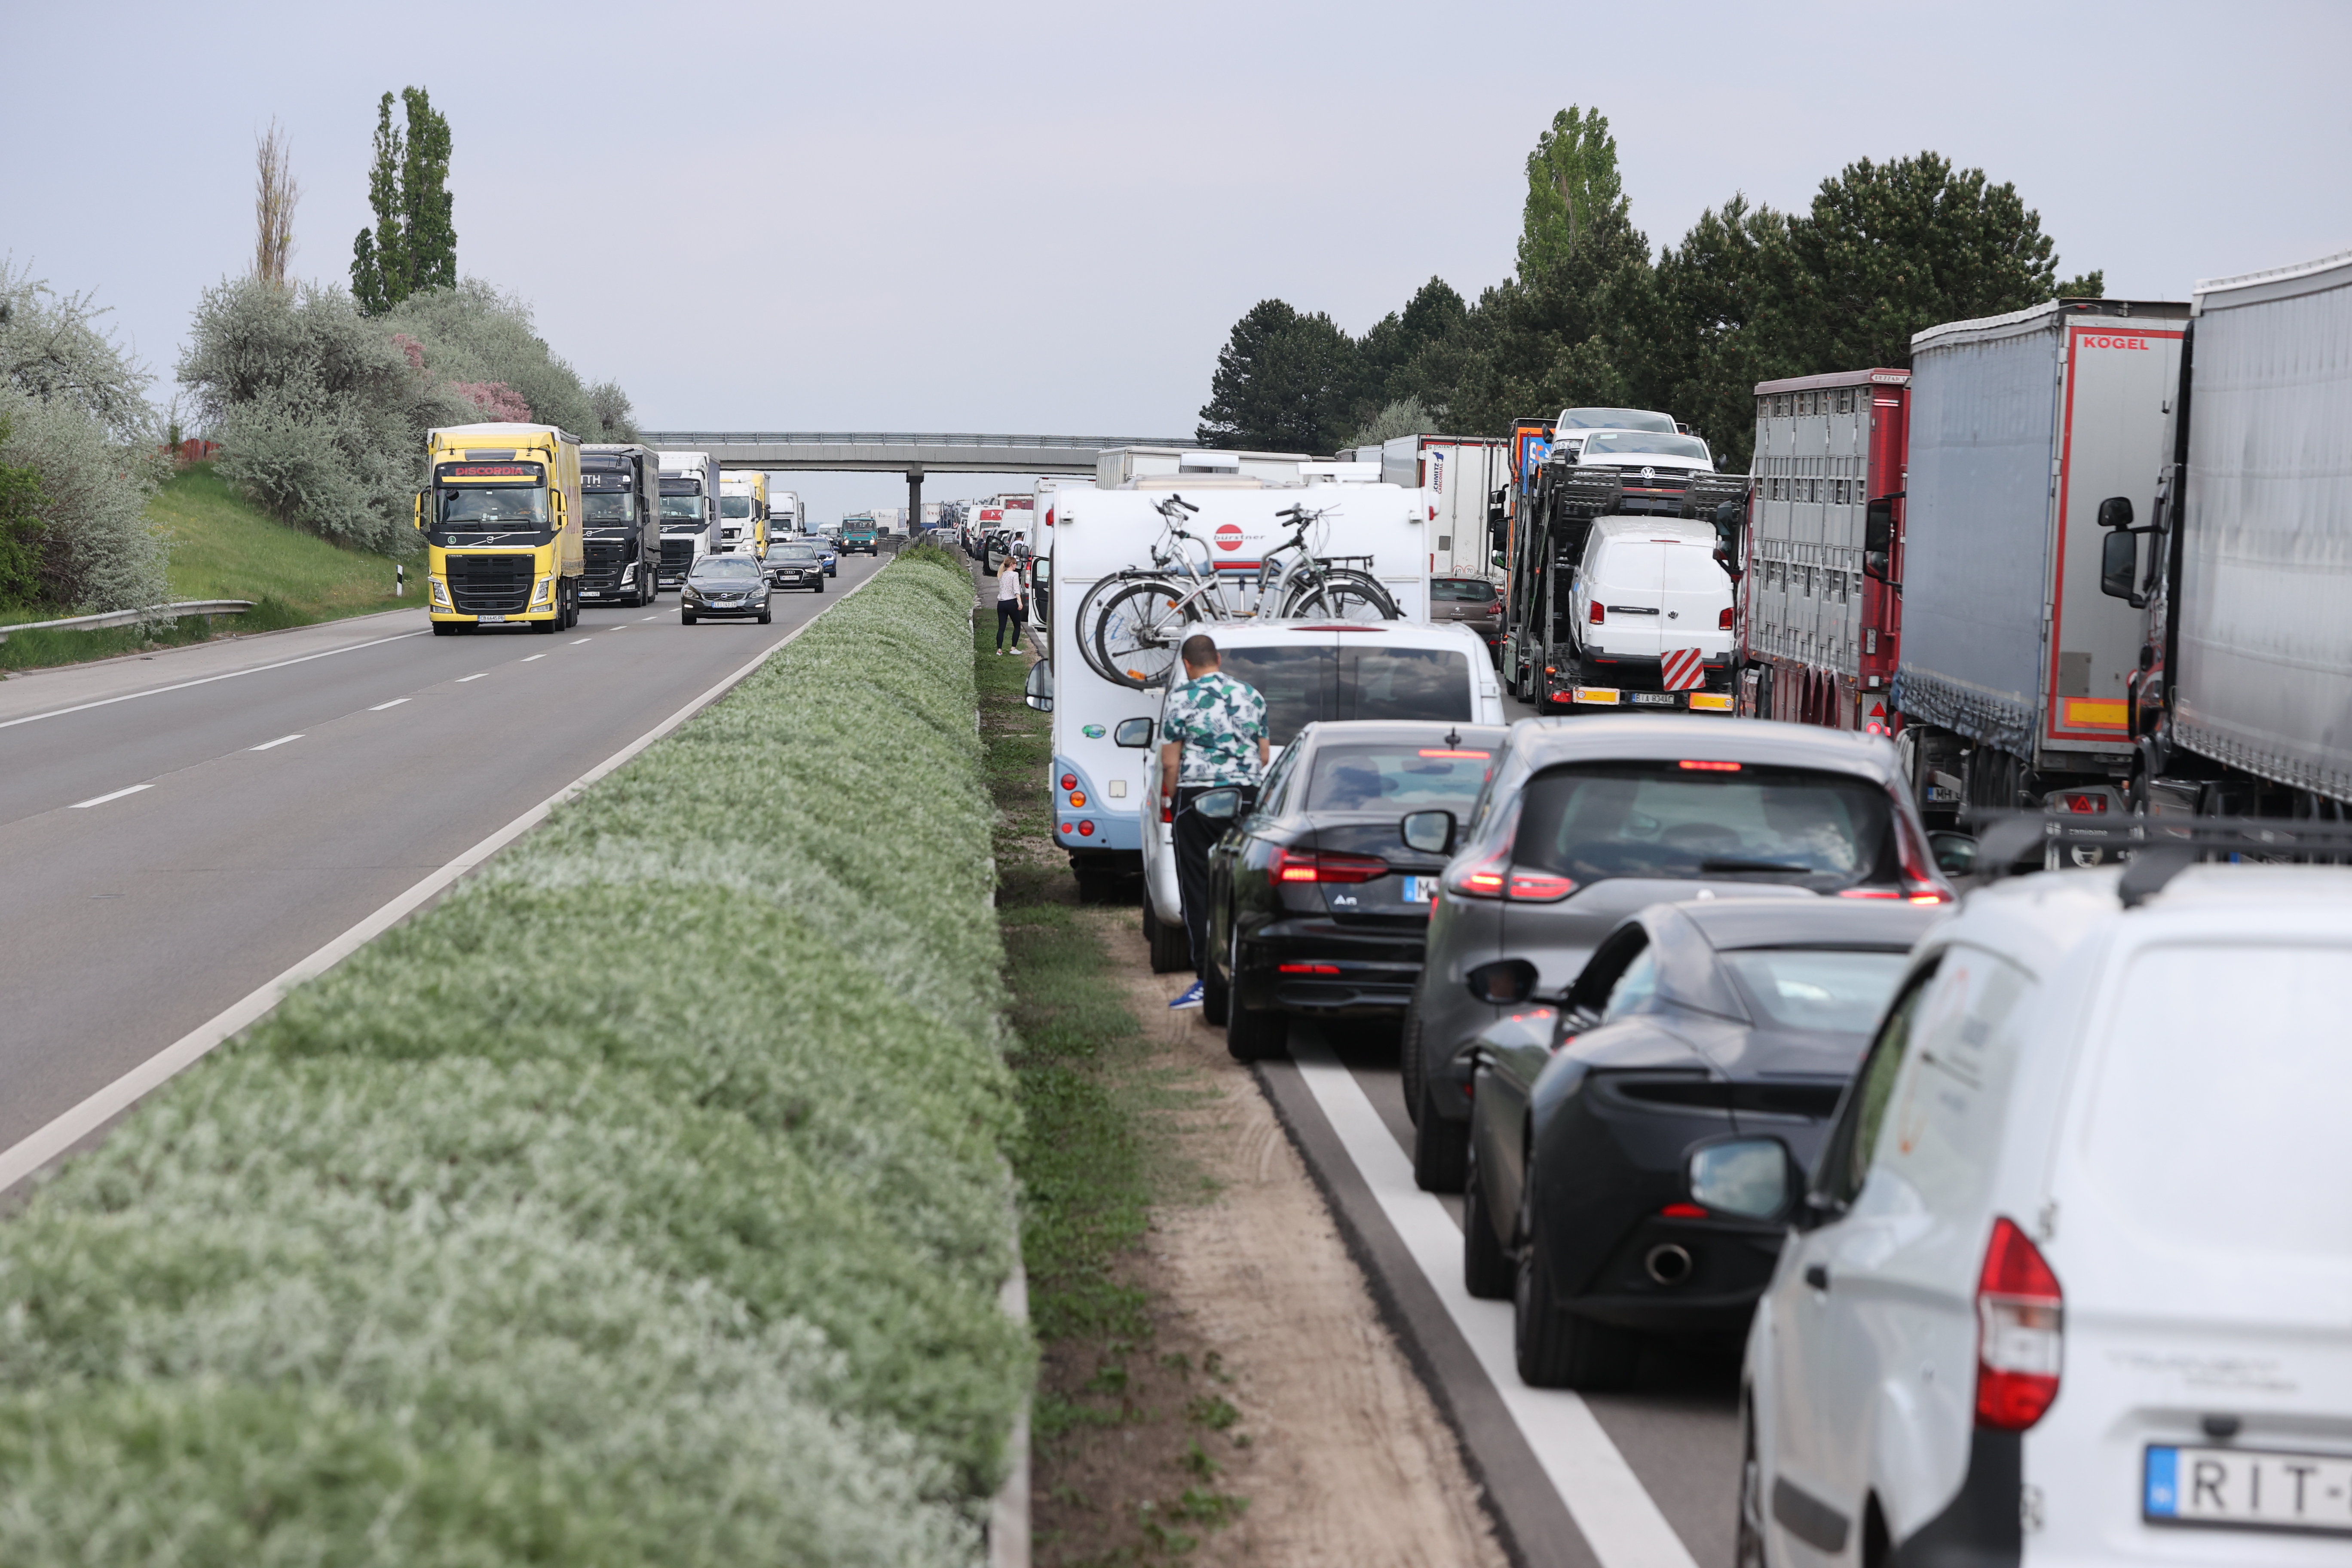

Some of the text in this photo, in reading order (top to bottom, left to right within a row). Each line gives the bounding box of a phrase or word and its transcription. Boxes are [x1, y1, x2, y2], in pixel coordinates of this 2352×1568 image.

[2084, 336, 2149, 350] KÖGEL
[456, 467, 524, 476] DISCORDIA
[2193, 1461, 2352, 1515] RIT-
